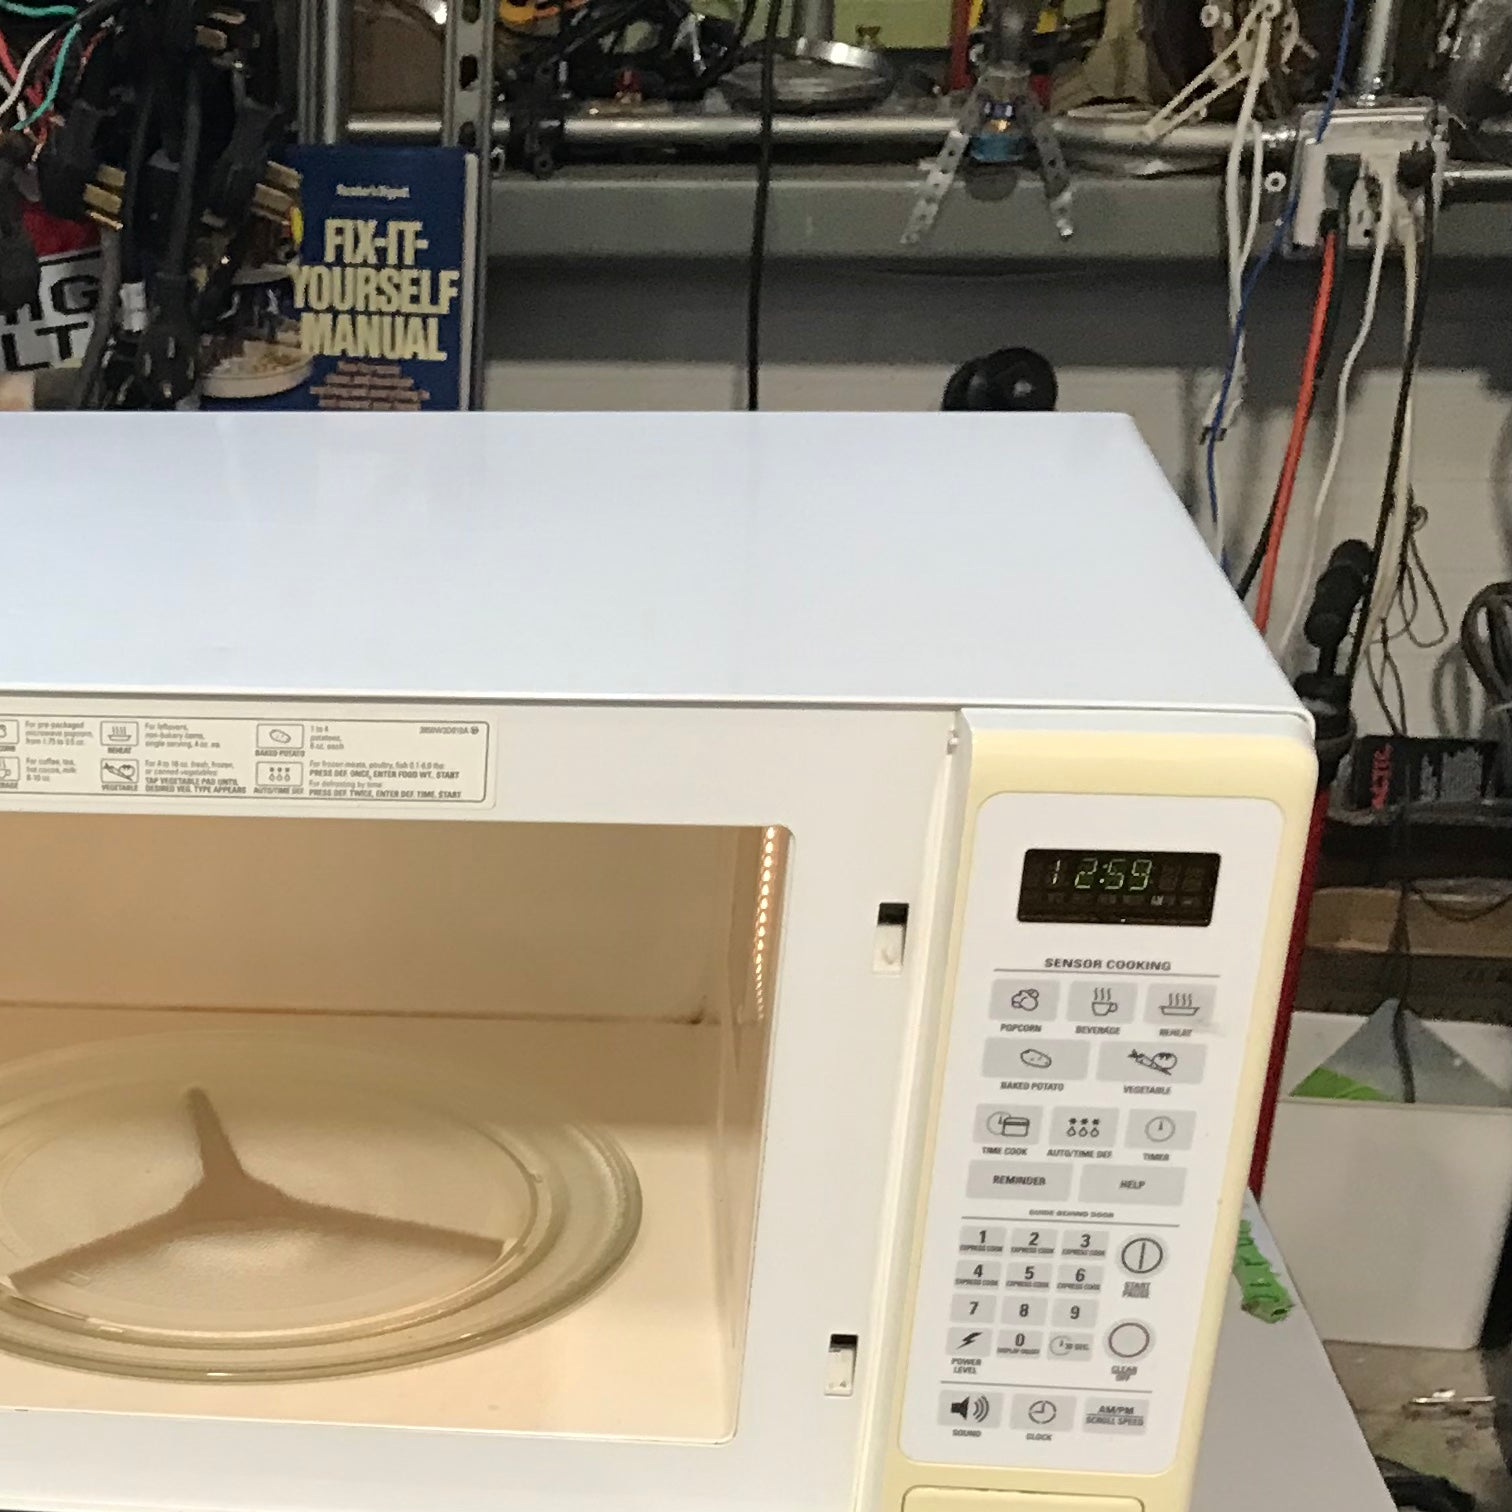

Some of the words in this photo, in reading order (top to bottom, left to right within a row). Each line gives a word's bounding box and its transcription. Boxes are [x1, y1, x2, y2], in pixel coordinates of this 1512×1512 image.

[324, 217, 429, 265] FIX-IT-
[287, 263, 460, 314] YOURSELF
[300, 310, 447, 361] MANUAL
[309, 769, 332, 777] PRESS
[309, 789, 332, 797] PRESS
[1044, 957, 1103, 970] SENSOR
[1105, 960, 1172, 972] COOKING
[999, 1022, 1043, 1033] POPCORN
[1074, 1024, 1121, 1036] BEVERAGE
[999, 1081, 1030, 1091] BAKED
[1030, 1083, 1065, 1092] POTATO
[1122, 1085, 1172, 1095] VEGETABLE
[981, 1146, 1003, 1156] TIME
[1004, 1147, 1029, 1157] COOK
[992, 1174, 1047, 1187] REMINDER
[1119, 1179, 1147, 1191] HELP
[979, 1229, 987, 1244] 1
[1029, 1231, 1040, 1246] 2
[1080, 1233, 1092, 1249] 3
[972, 1263, 984, 1278] 4
[1024, 1265, 1036, 1280] 5
[1075, 1267, 1087, 1282] 6
[968, 1301, 979, 1315] 7
[1018, 1303, 1030, 1318] 8
[1070, 1305, 1081, 1320] 9
[950, 1358, 982, 1367] POWER
[953, 1366, 977, 1375] LEVEL
[1098, 1405, 1135, 1415] AM/PM
[952, 1428, 983, 1438] SOUND
[1025, 1432, 1053, 1442] CLOCK
